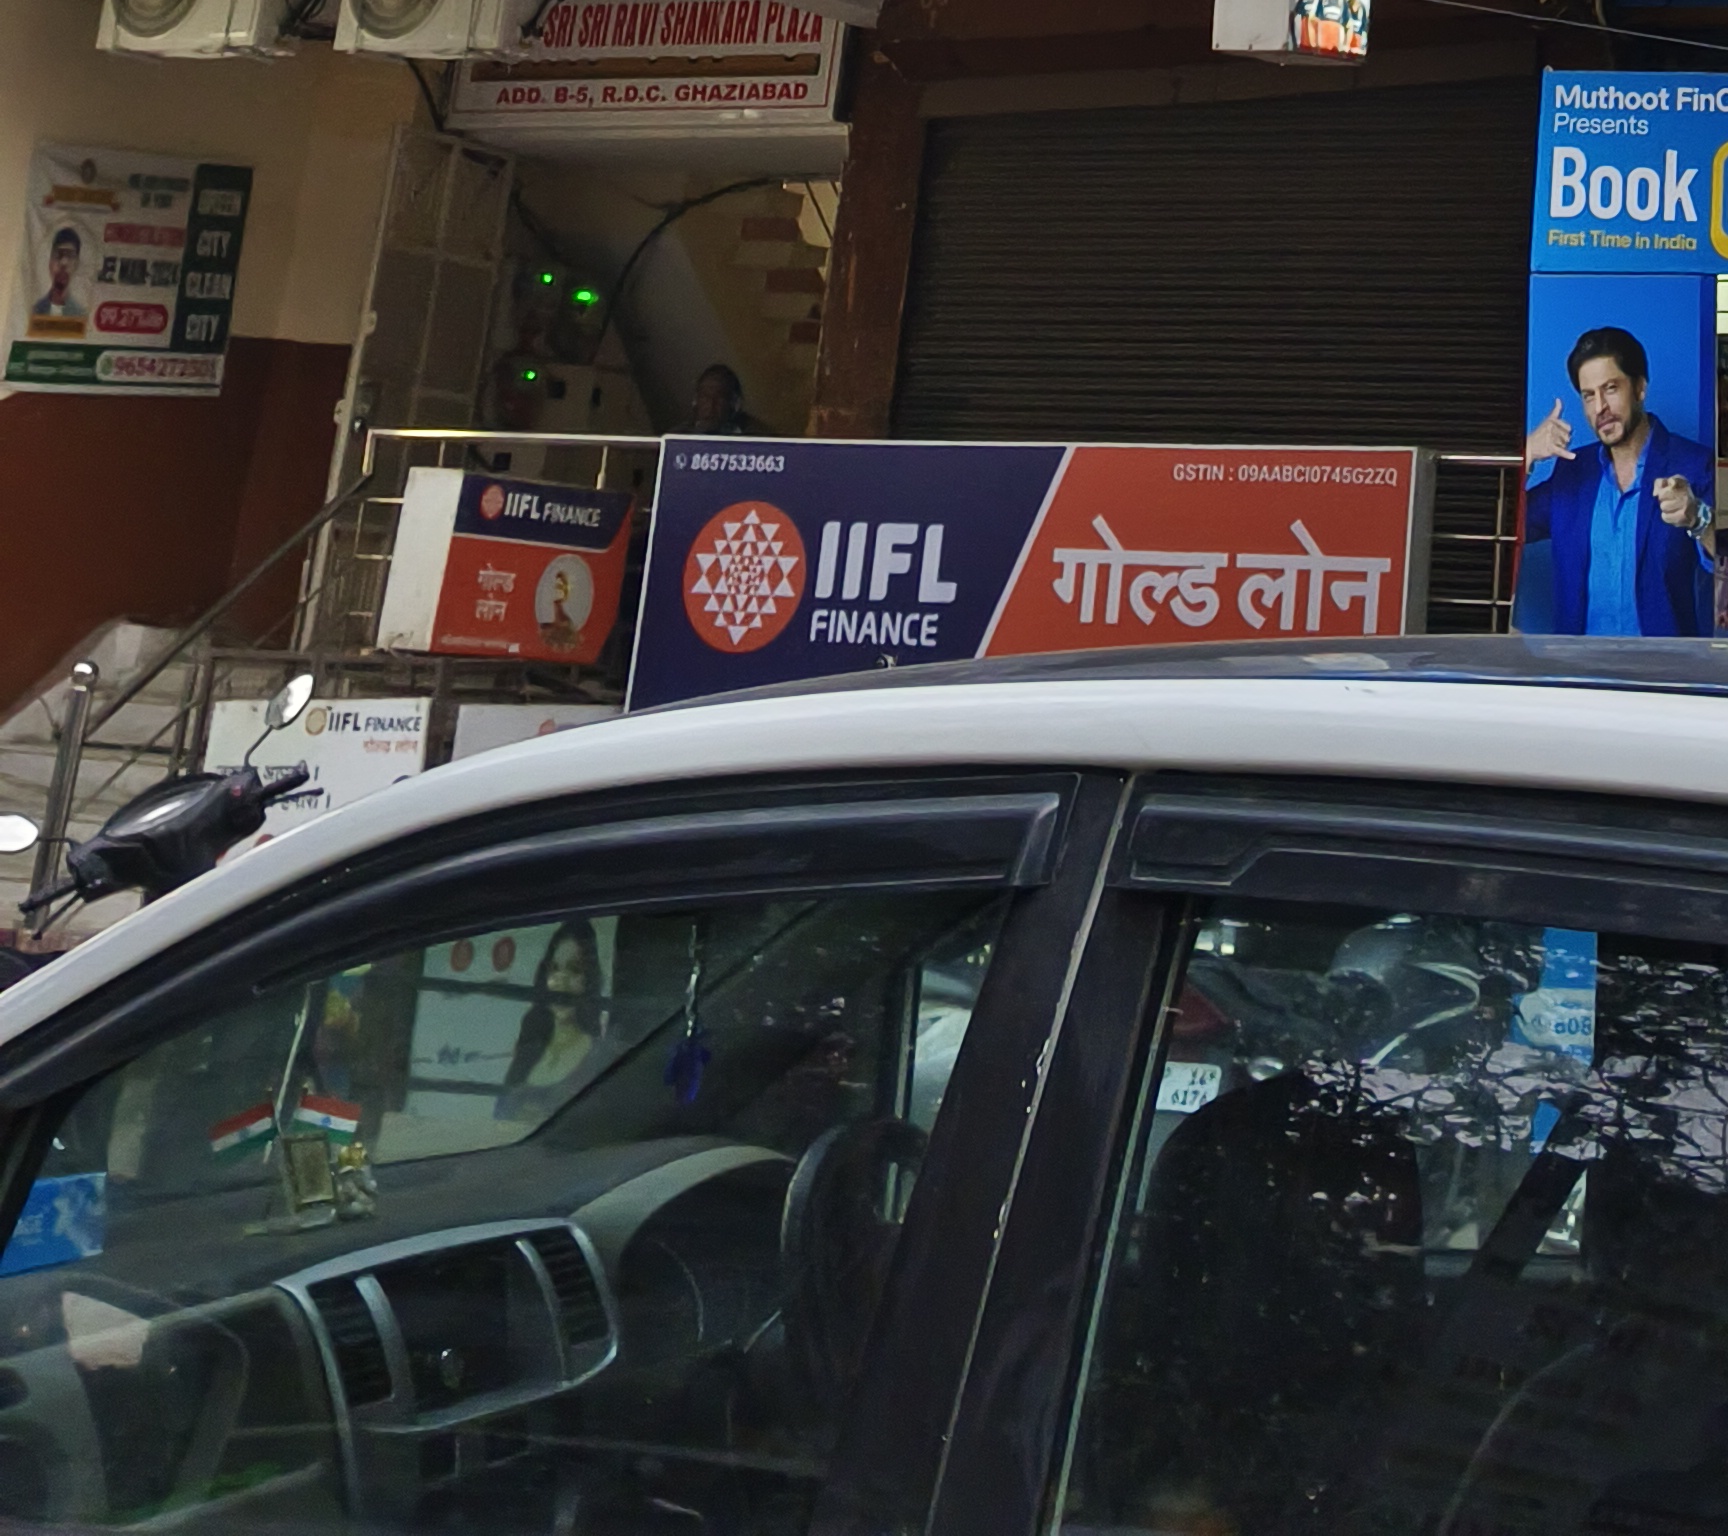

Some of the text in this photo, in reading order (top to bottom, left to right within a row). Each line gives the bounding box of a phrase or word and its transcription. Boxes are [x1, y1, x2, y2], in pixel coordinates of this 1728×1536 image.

[543, 4, 578, 49] SRI
[577, 3, 614, 48] SRI
[612, 1, 660, 47] RAVI
[660, 0, 763, 45] SHANKARA
[553, 85, 594, 107] B-5,
[600, 84, 667, 103] R.D.C.
[674, 81, 809, 103] GHAZIABAD
[1555, 84, 1670, 112] Muthoot
[1552, 112, 1650, 136] Presents
[1549, 145, 1699, 223] Book
[1548, 229, 1698, 252] First Time in India
[688, 453, 786, 475] 8657533663
[1173, 462, 1225, 483] GSTIN
[504, 491, 602, 528] IIFL FINANCE
[813, 519, 959, 605] IIFL
[1051, 513, 1392, 636] गोल्ड लोन
[808, 608, 940, 648] FINANCE
[327, 709, 422, 734] IIFL FINANCE
